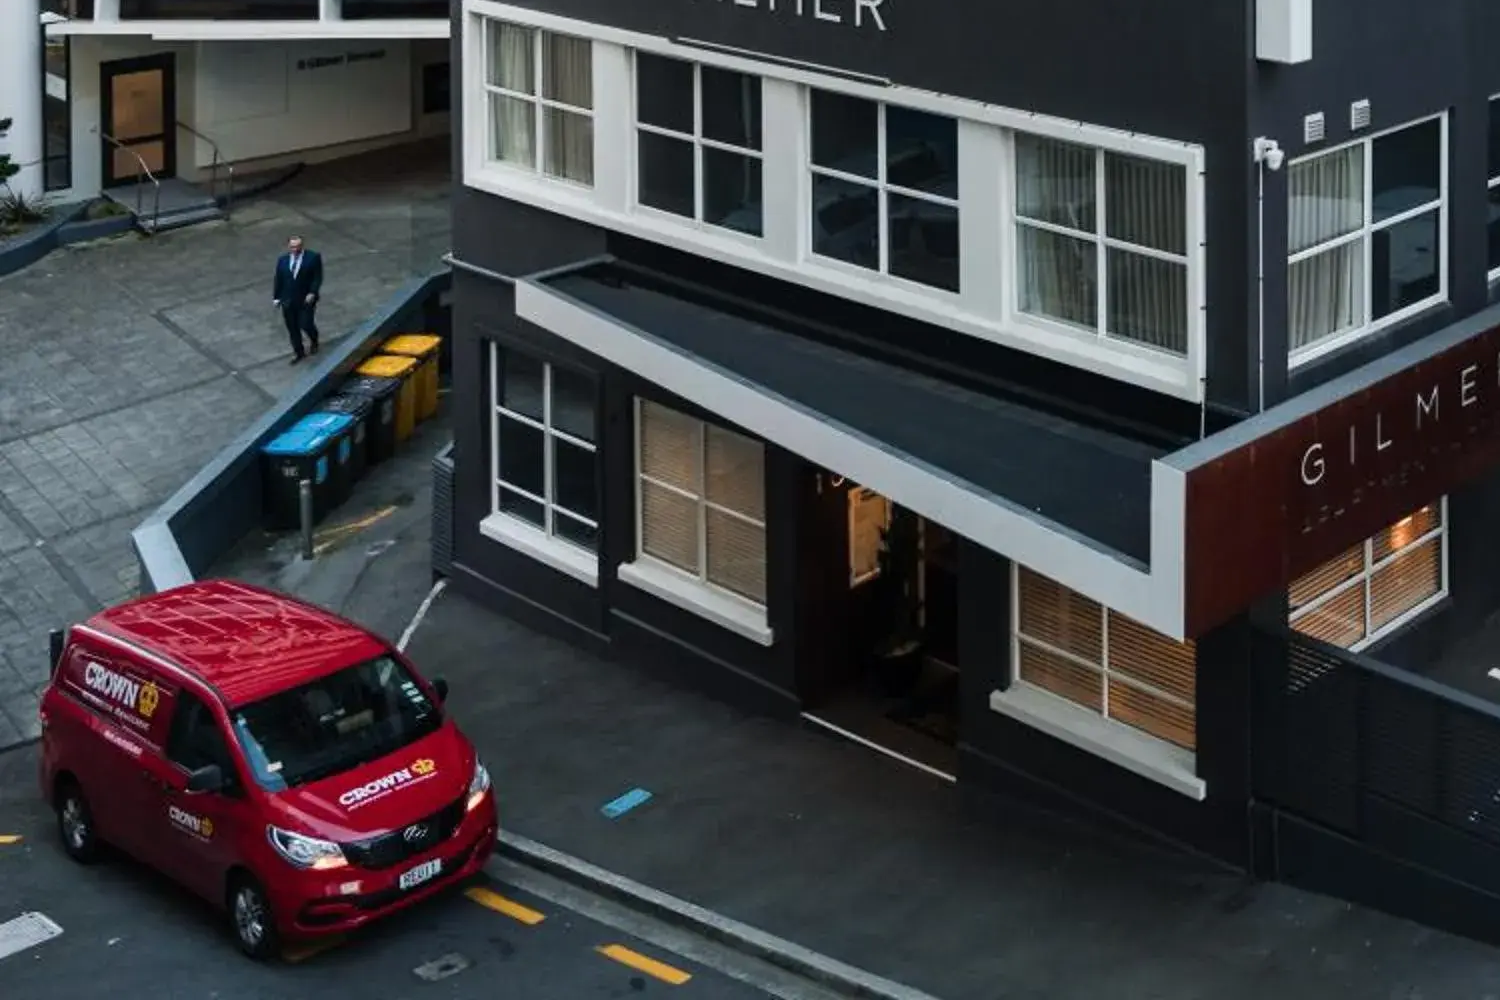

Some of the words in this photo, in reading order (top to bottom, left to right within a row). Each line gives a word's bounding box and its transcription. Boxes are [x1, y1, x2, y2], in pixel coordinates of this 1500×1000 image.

[85, 662, 139, 708] CROWN
[339, 768, 413, 806] CROWN
[169, 805, 201, 832] CROWN
